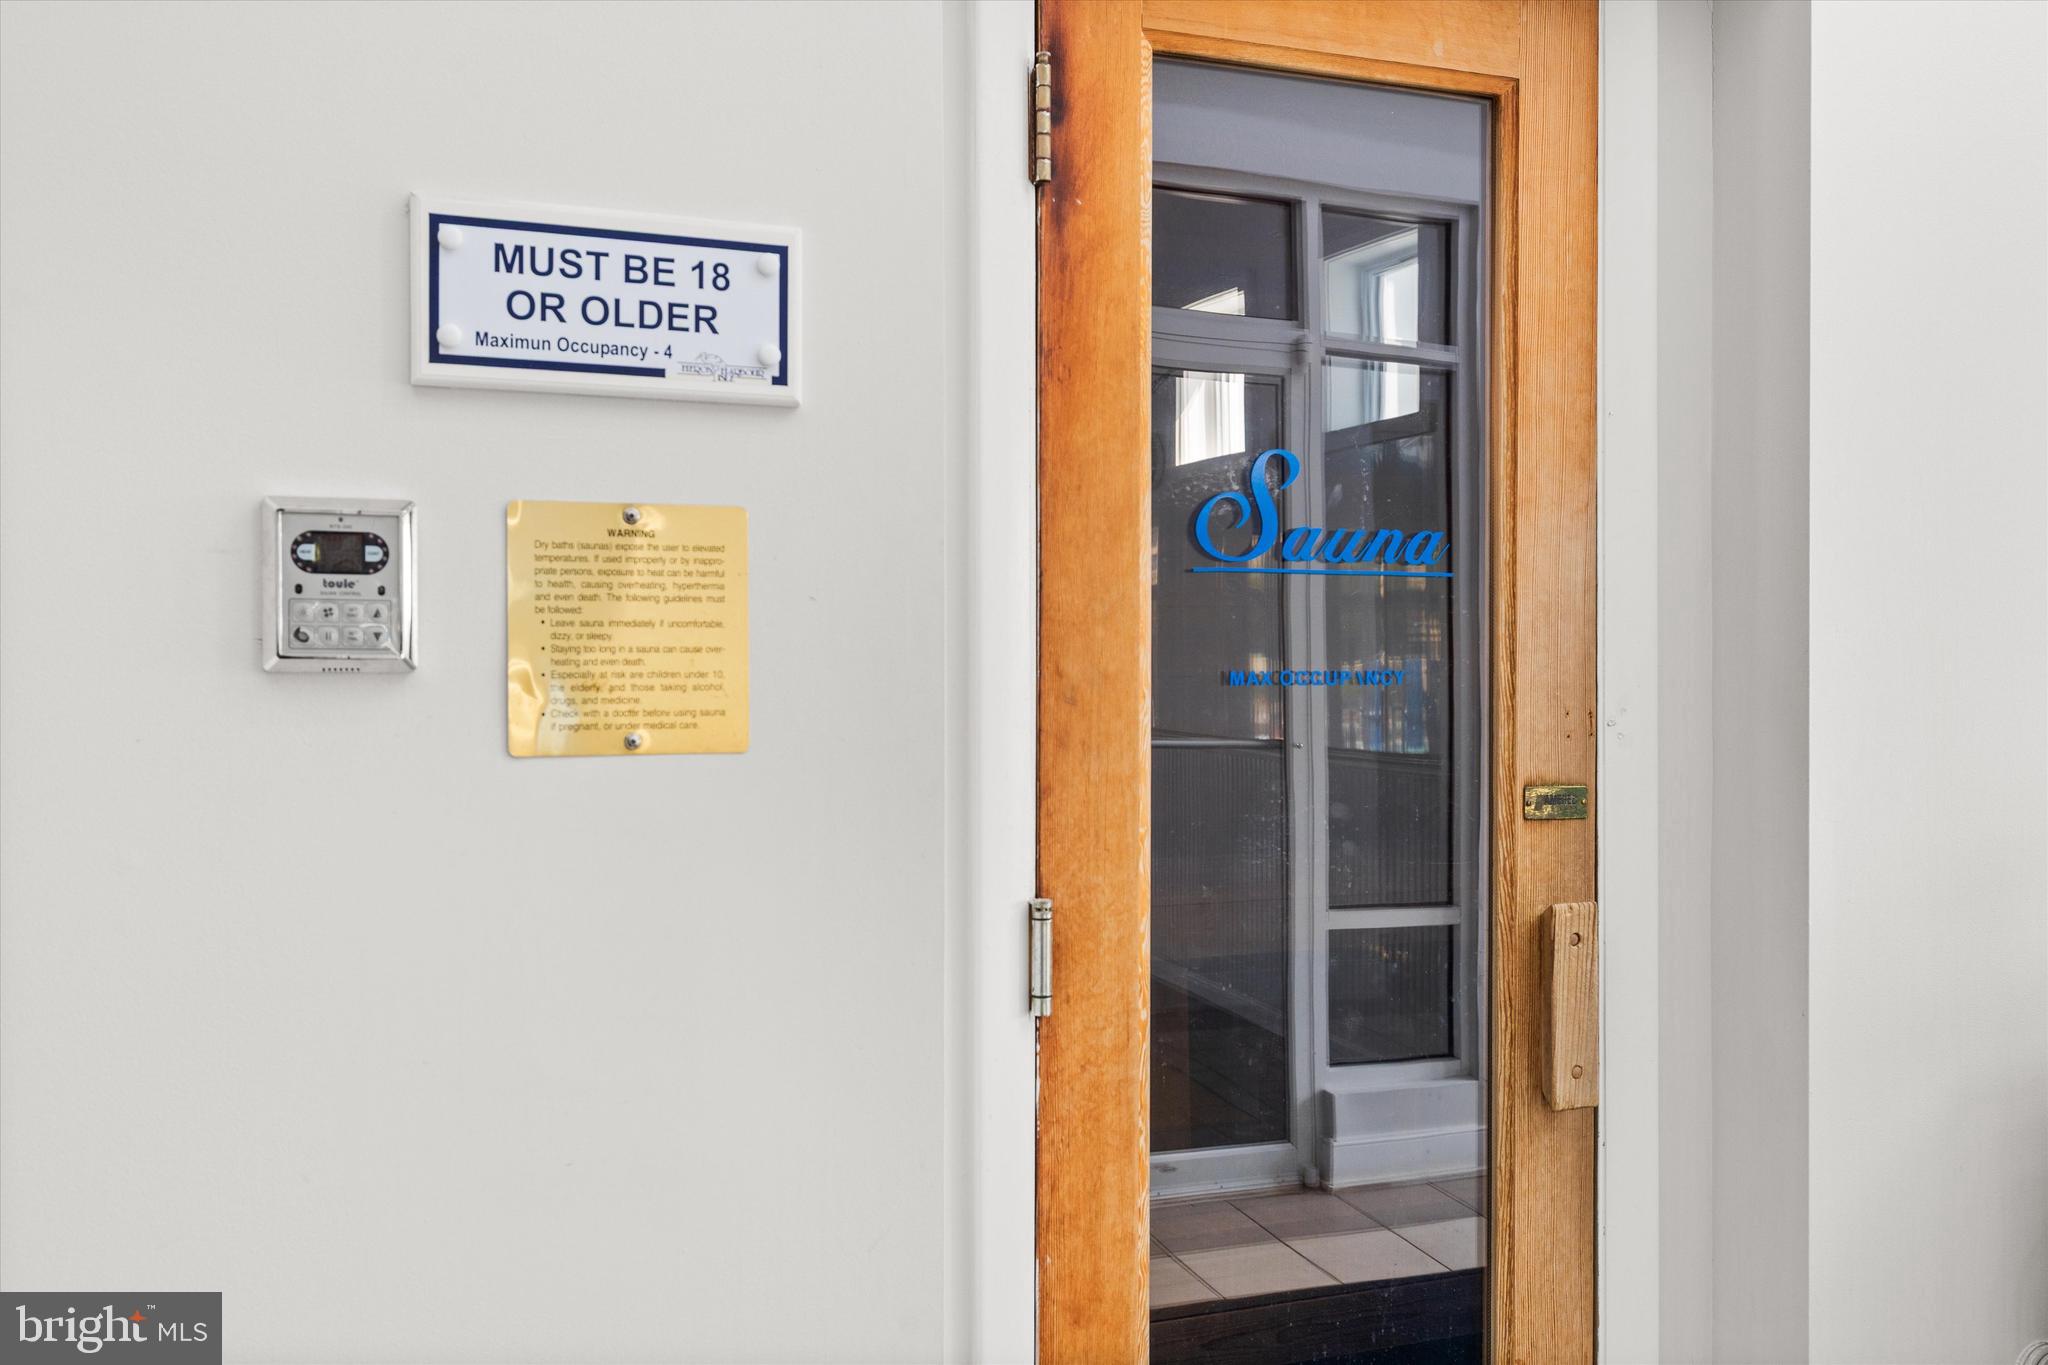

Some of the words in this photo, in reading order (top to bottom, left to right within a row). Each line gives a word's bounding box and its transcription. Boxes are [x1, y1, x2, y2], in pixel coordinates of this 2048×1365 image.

[493, 242, 609, 281] MUST
[623, 253, 676, 287] BE
[691, 260, 731, 292] 18
[506, 290, 567, 323] OR
[581, 295, 720, 335] OLDER
[475, 331, 552, 351] Maximun
[556, 337, 648, 361] Occupancy
[664, 344, 673, 359] 4
[1194, 448, 1450, 565] Sauna
[607, 528, 655, 538] WARNING
[534, 540, 548, 551] Dry
[535, 593, 551, 601] and
[535, 605, 544, 614] be
[550, 619, 575, 627] Leave
[551, 644, 581, 655] Staying
[550, 659, 581, 668] heating
[550, 670, 595, 679] Especially
[646, 671, 681, 679] children
[684, 671, 708, 679] under
[1229, 670, 1273, 687] MAX
[660, 684, 687, 693] taking
[673, 710, 697, 719] using
